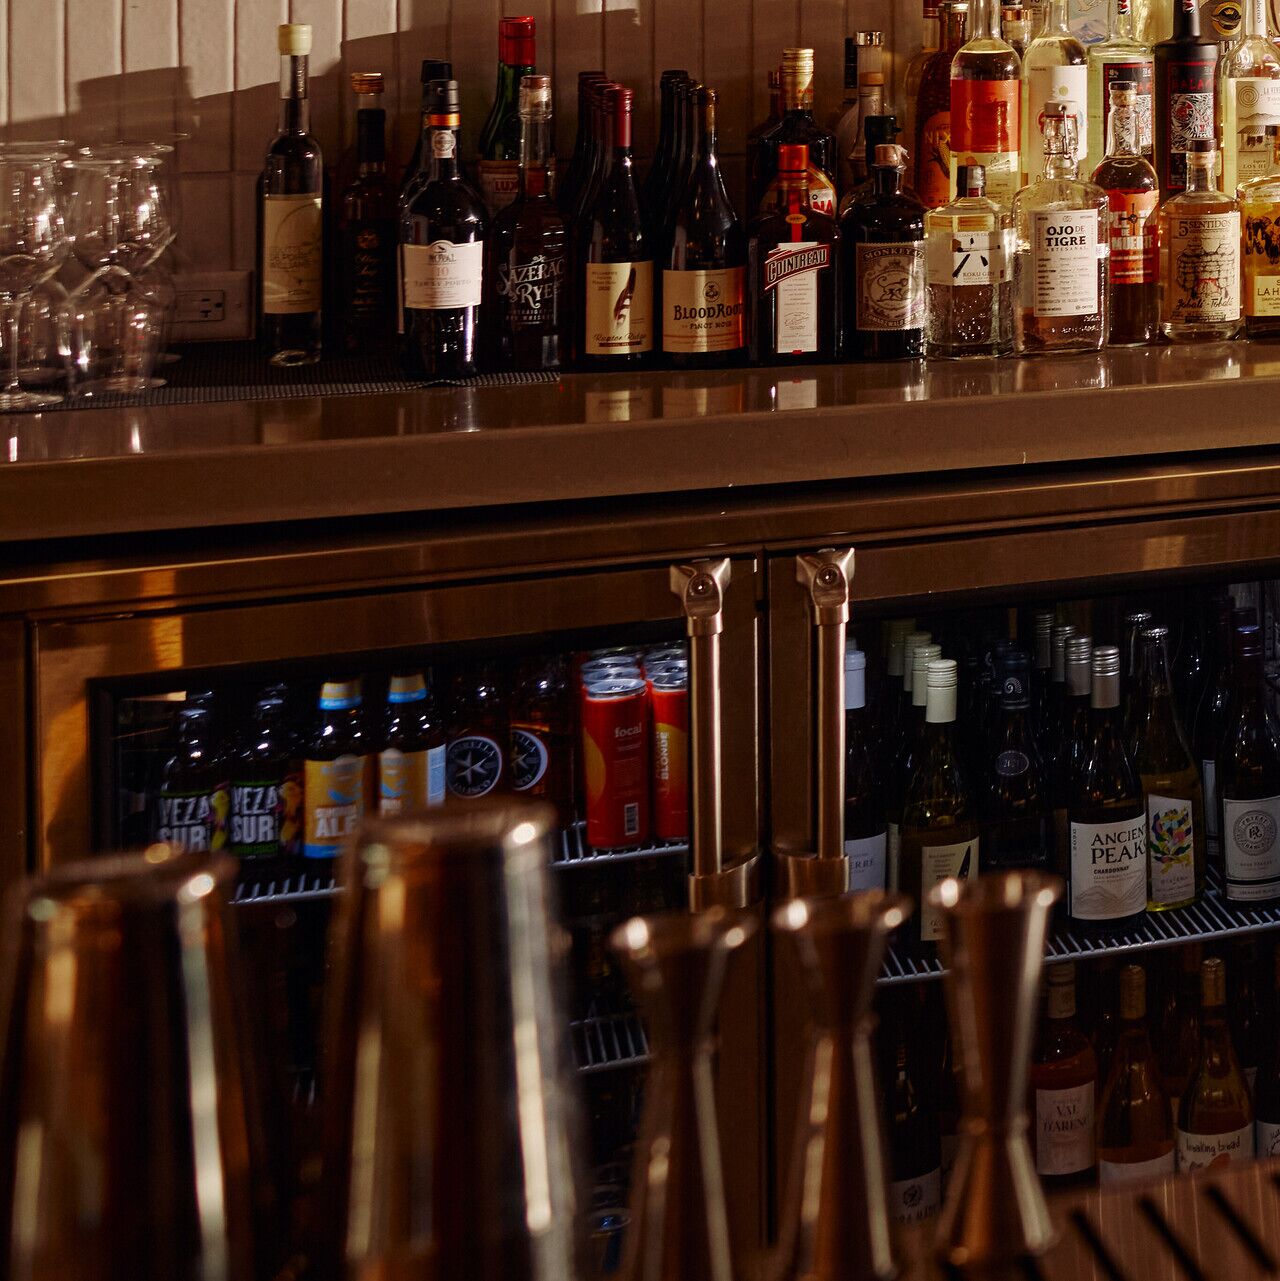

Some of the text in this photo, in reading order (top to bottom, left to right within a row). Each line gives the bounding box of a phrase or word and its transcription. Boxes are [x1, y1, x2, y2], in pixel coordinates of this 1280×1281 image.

[1046, 224, 1085, 237] OJO DE
[1178, 221, 1189, 237] 5
[1045, 235, 1087, 247] TIGRE
[767, 248, 827, 283] COINTREAU
[863, 247, 914, 262] MONKEY
[496, 258, 568, 296] SAZERAC
[516, 282, 560, 309] RYE
[1257, 288, 1270, 297] LA
[613, 721, 643, 739] focal
[660, 731, 670, 780] BLONDE
[159, 795, 211, 827] VEZA
[230, 785, 279, 816] VEZA
[229, 814, 277, 844] SUR
[1093, 865, 1130, 875] CHARDONNAY
